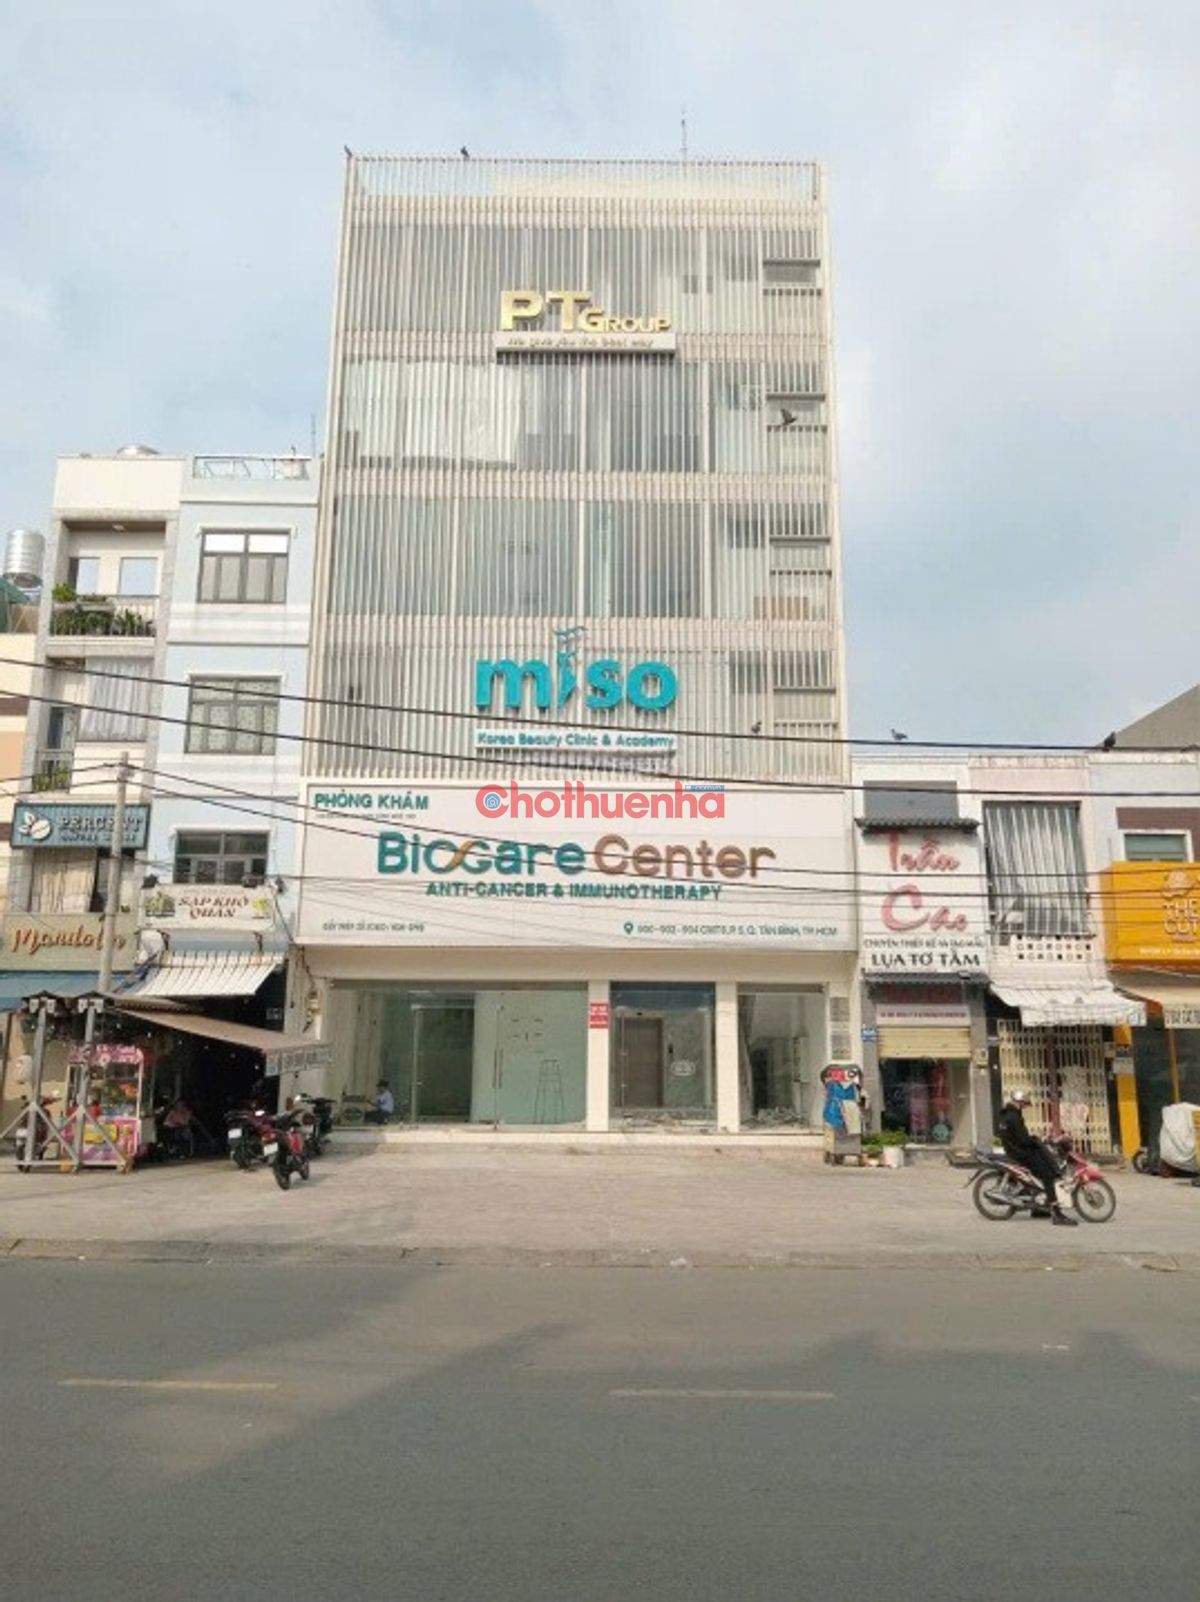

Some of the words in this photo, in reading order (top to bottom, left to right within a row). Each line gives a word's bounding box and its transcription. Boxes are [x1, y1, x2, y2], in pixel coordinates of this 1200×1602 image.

[475, 650, 678, 711] miso
[518, 733, 562, 747] Beauty
[564, 733, 598, 746] Clinic
[602, 734, 612, 746] &
[616, 734, 674, 751] Academy
[594, 834, 777, 879] Center
[426, 881, 549, 899] ANTI-CANCER
[553, 883, 563, 899] &
[569, 883, 722, 902] IMMUNOTHERAPY
[881, 884, 967, 932] Cao
